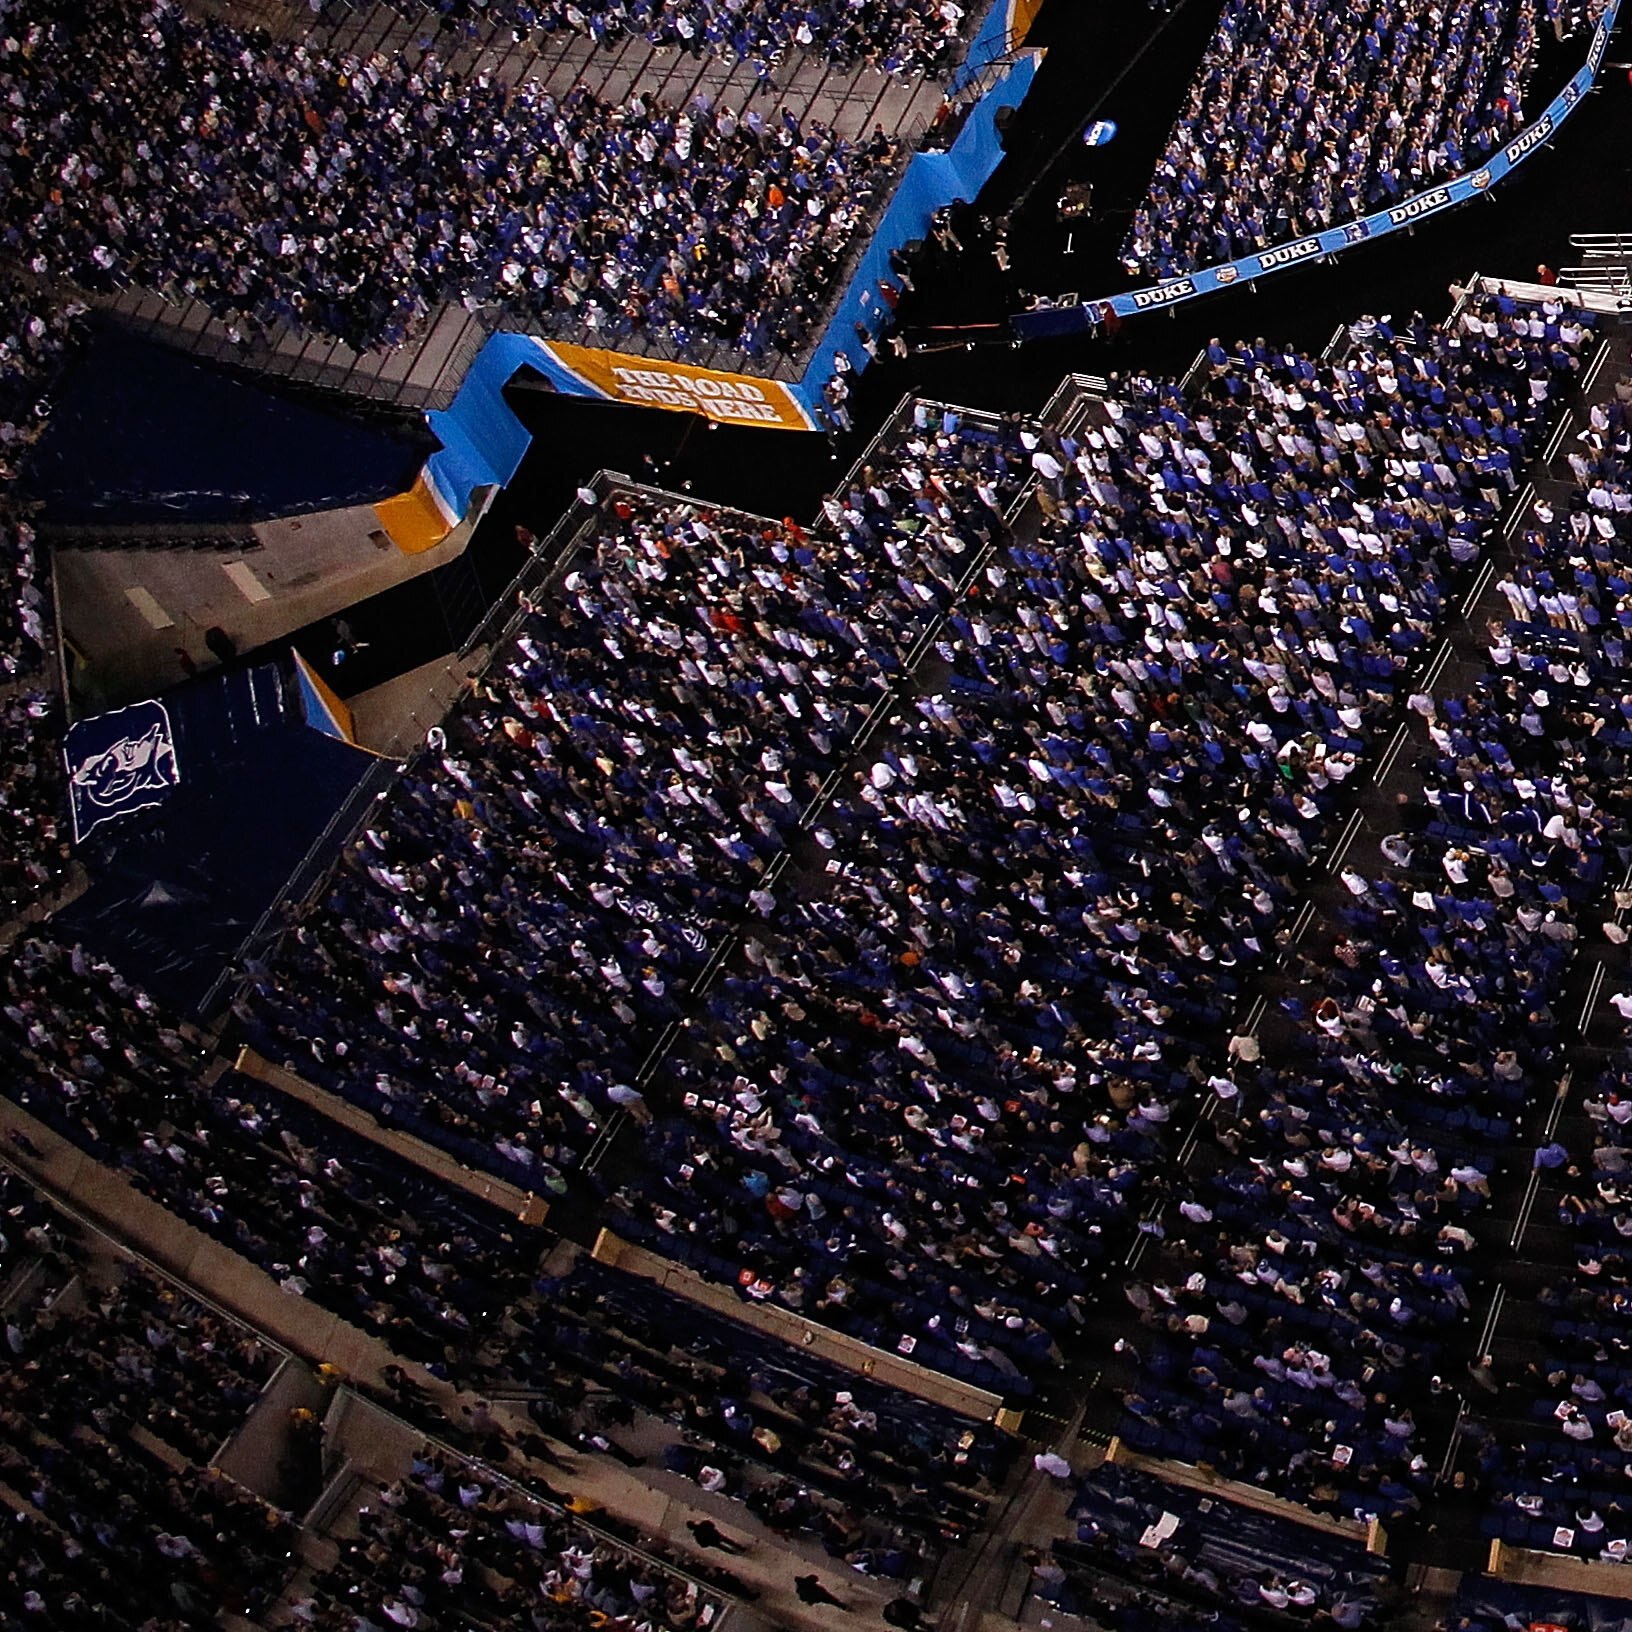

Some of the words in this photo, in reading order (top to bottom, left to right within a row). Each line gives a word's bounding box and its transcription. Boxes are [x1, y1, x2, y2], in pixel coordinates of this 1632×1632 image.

[1506, 117, 1552, 162] DUKE
[1390, 189, 1449, 223] DUKE
[1259, 240, 1320, 269] DUKE
[1135, 280, 1195, 308] DUKE
[611, 367, 680, 390] THE
[673, 374, 765, 402] ROAD
[615, 383, 699, 408] ENDS
